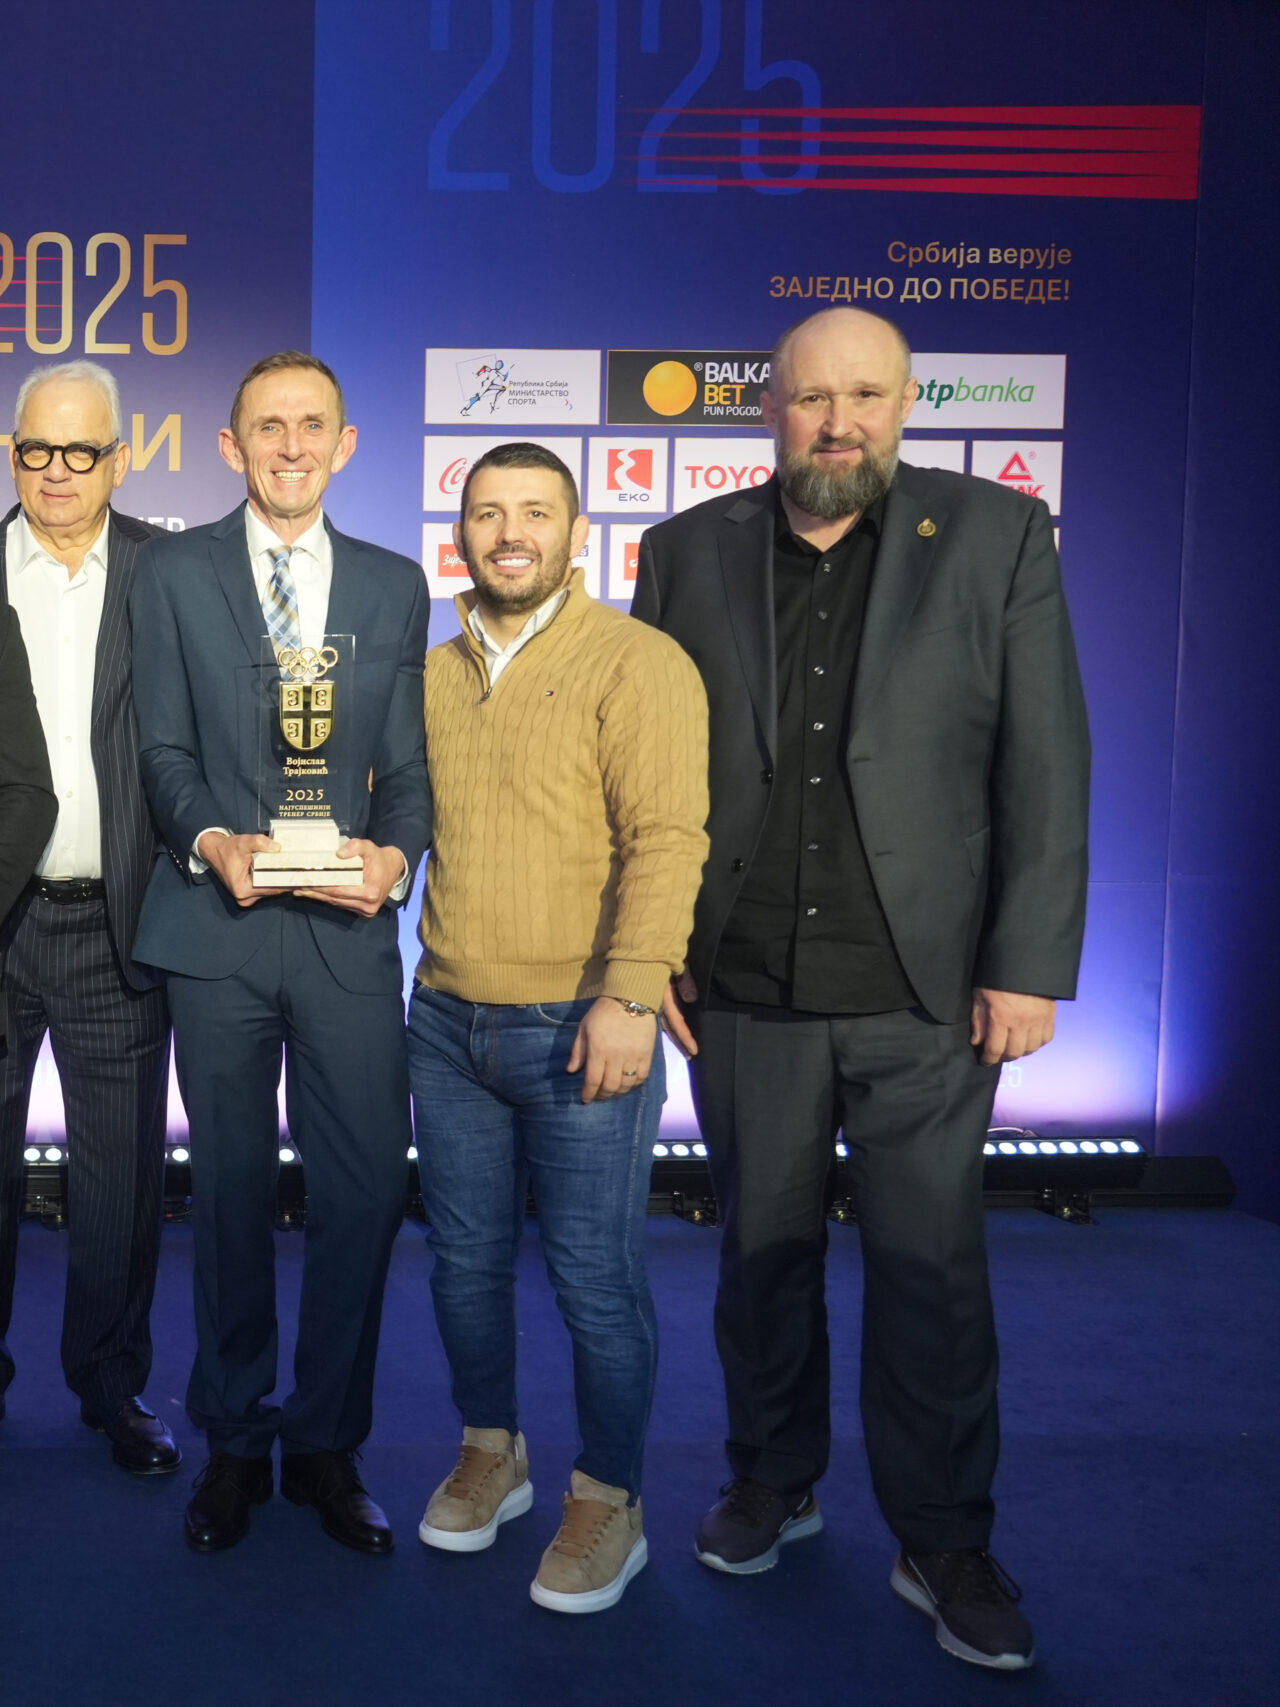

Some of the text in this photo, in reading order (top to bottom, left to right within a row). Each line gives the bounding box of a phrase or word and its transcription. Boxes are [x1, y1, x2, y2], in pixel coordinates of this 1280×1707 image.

[427, 0, 822, 195] 2025
[887, 241, 1072, 269] Србија верује
[770, 275, 1070, 304] ЗАЈЕДНО ДО ПОБЕДЕ!
[704, 384, 746, 405] BET
[703, 406, 724, 416] PUN
[619, 493, 650, 502] EKO
[286, 757, 326, 767] Војислав
[282, 766, 329, 776] Трајковић
[285, 789, 324, 801] 2025
